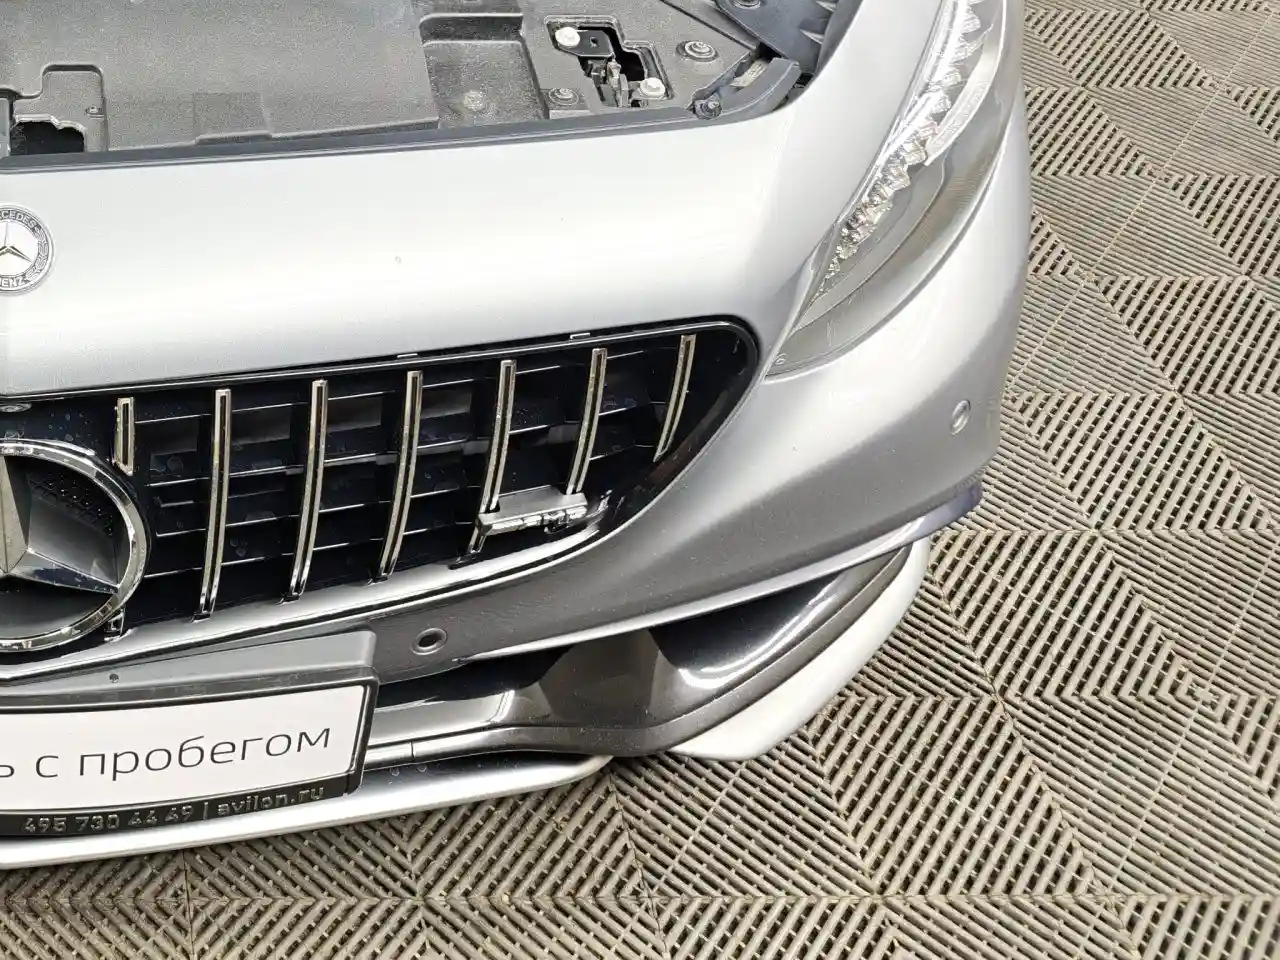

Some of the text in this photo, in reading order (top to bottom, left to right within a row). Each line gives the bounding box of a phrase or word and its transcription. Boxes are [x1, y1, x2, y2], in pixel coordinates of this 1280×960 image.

[35, 754, 60, 778] с
[78, 727, 331, 782] пробегом
[22, 816, 68, 834] 495
[75, 813, 120, 832] 730
[127, 810, 158, 826] 44
[165, 805, 194, 823] 49
[217, 786, 324, 817] avilon.ru
